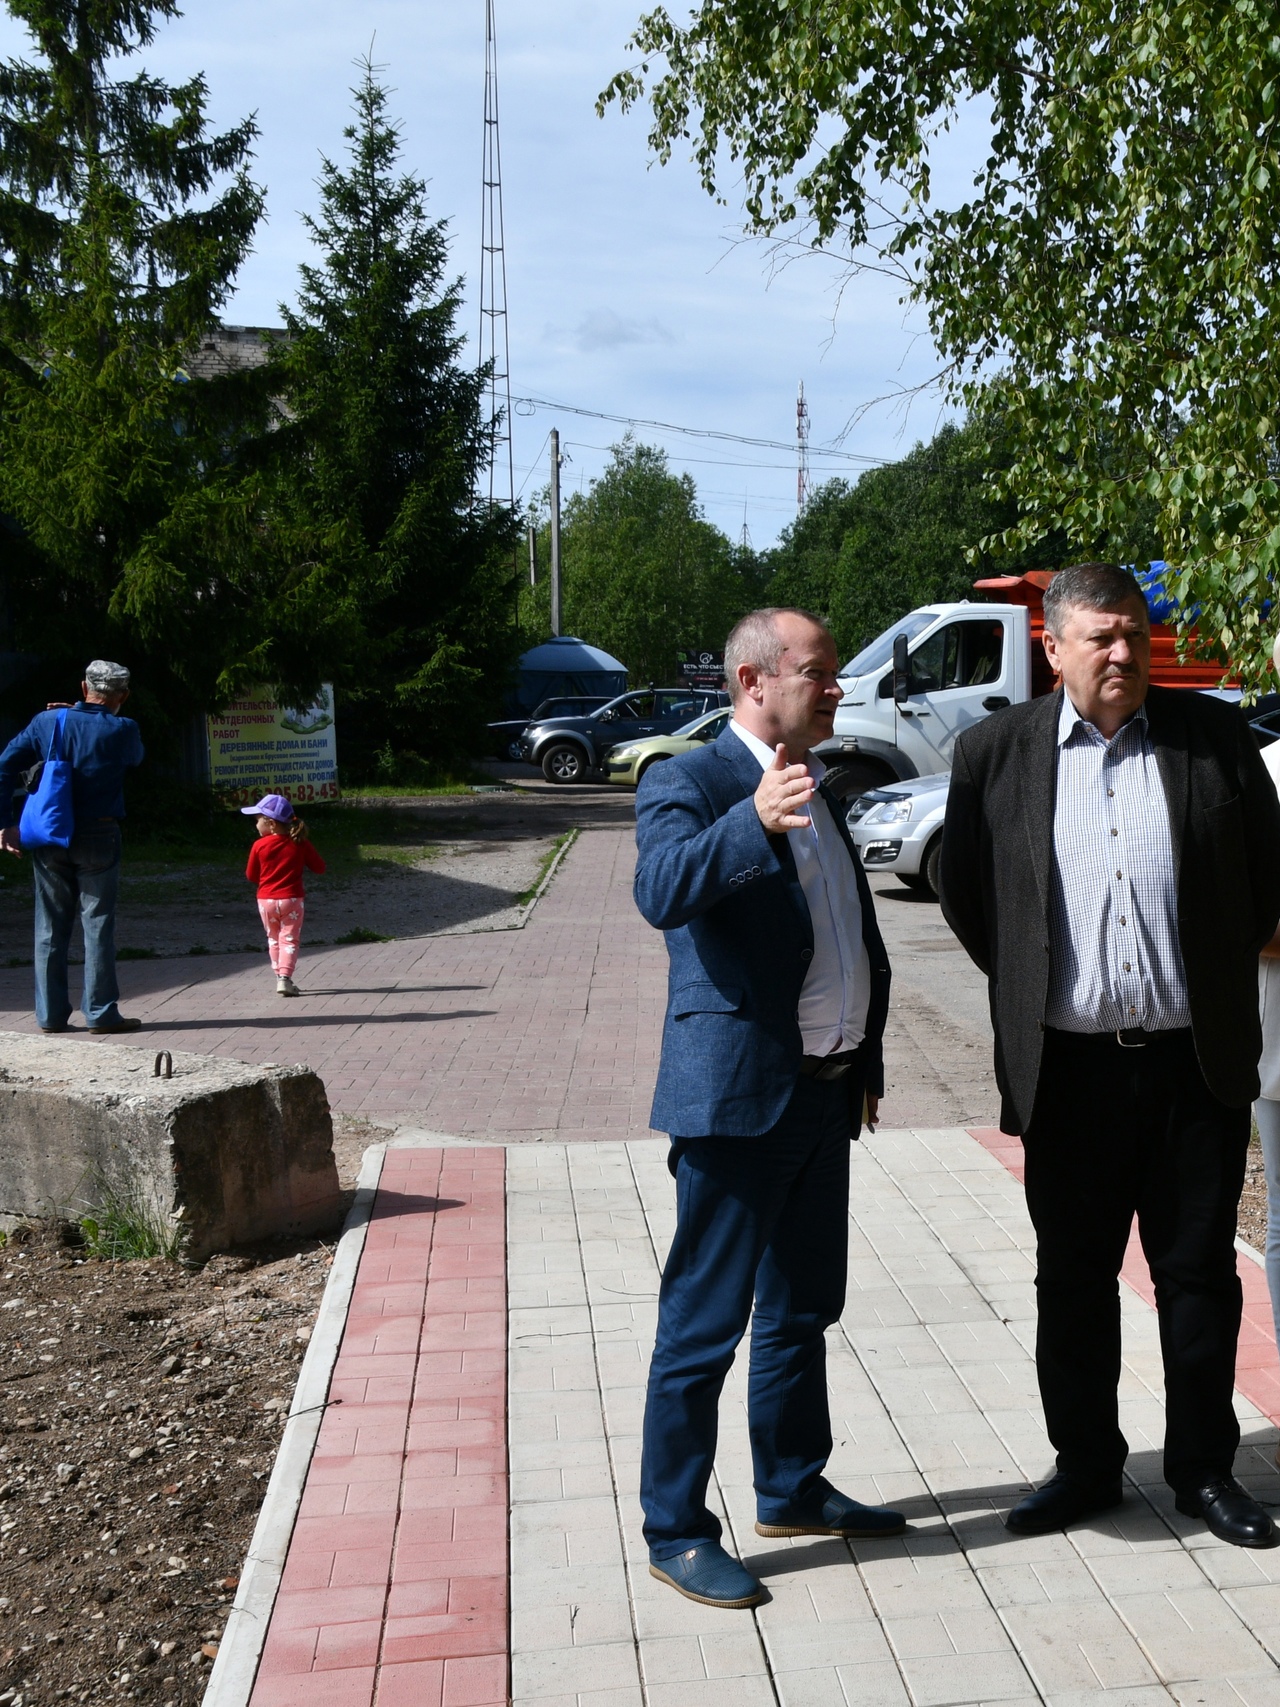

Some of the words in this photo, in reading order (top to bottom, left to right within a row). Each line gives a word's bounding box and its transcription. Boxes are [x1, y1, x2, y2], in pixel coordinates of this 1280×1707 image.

[213, 729, 240, 740] РАБОТ
[220, 740, 275, 755] ДЕРЕВЯННЫЕ
[276, 739, 300, 752] ДОМА
[300, 739, 307, 749] И
[307, 738, 328, 749] БАНИ
[214, 765, 239, 776] РЕМОНТ
[239, 764, 244, 775] И
[244, 761, 292, 774] РЕКОНСТРУКЦИЯ
[292, 760, 315, 771] СТАРЫХ
[315, 759, 335, 771] ДОМОВ
[273, 773, 304, 784] ЗАБОРЫ
[307, 771, 336, 783] КРОВЛЯ
